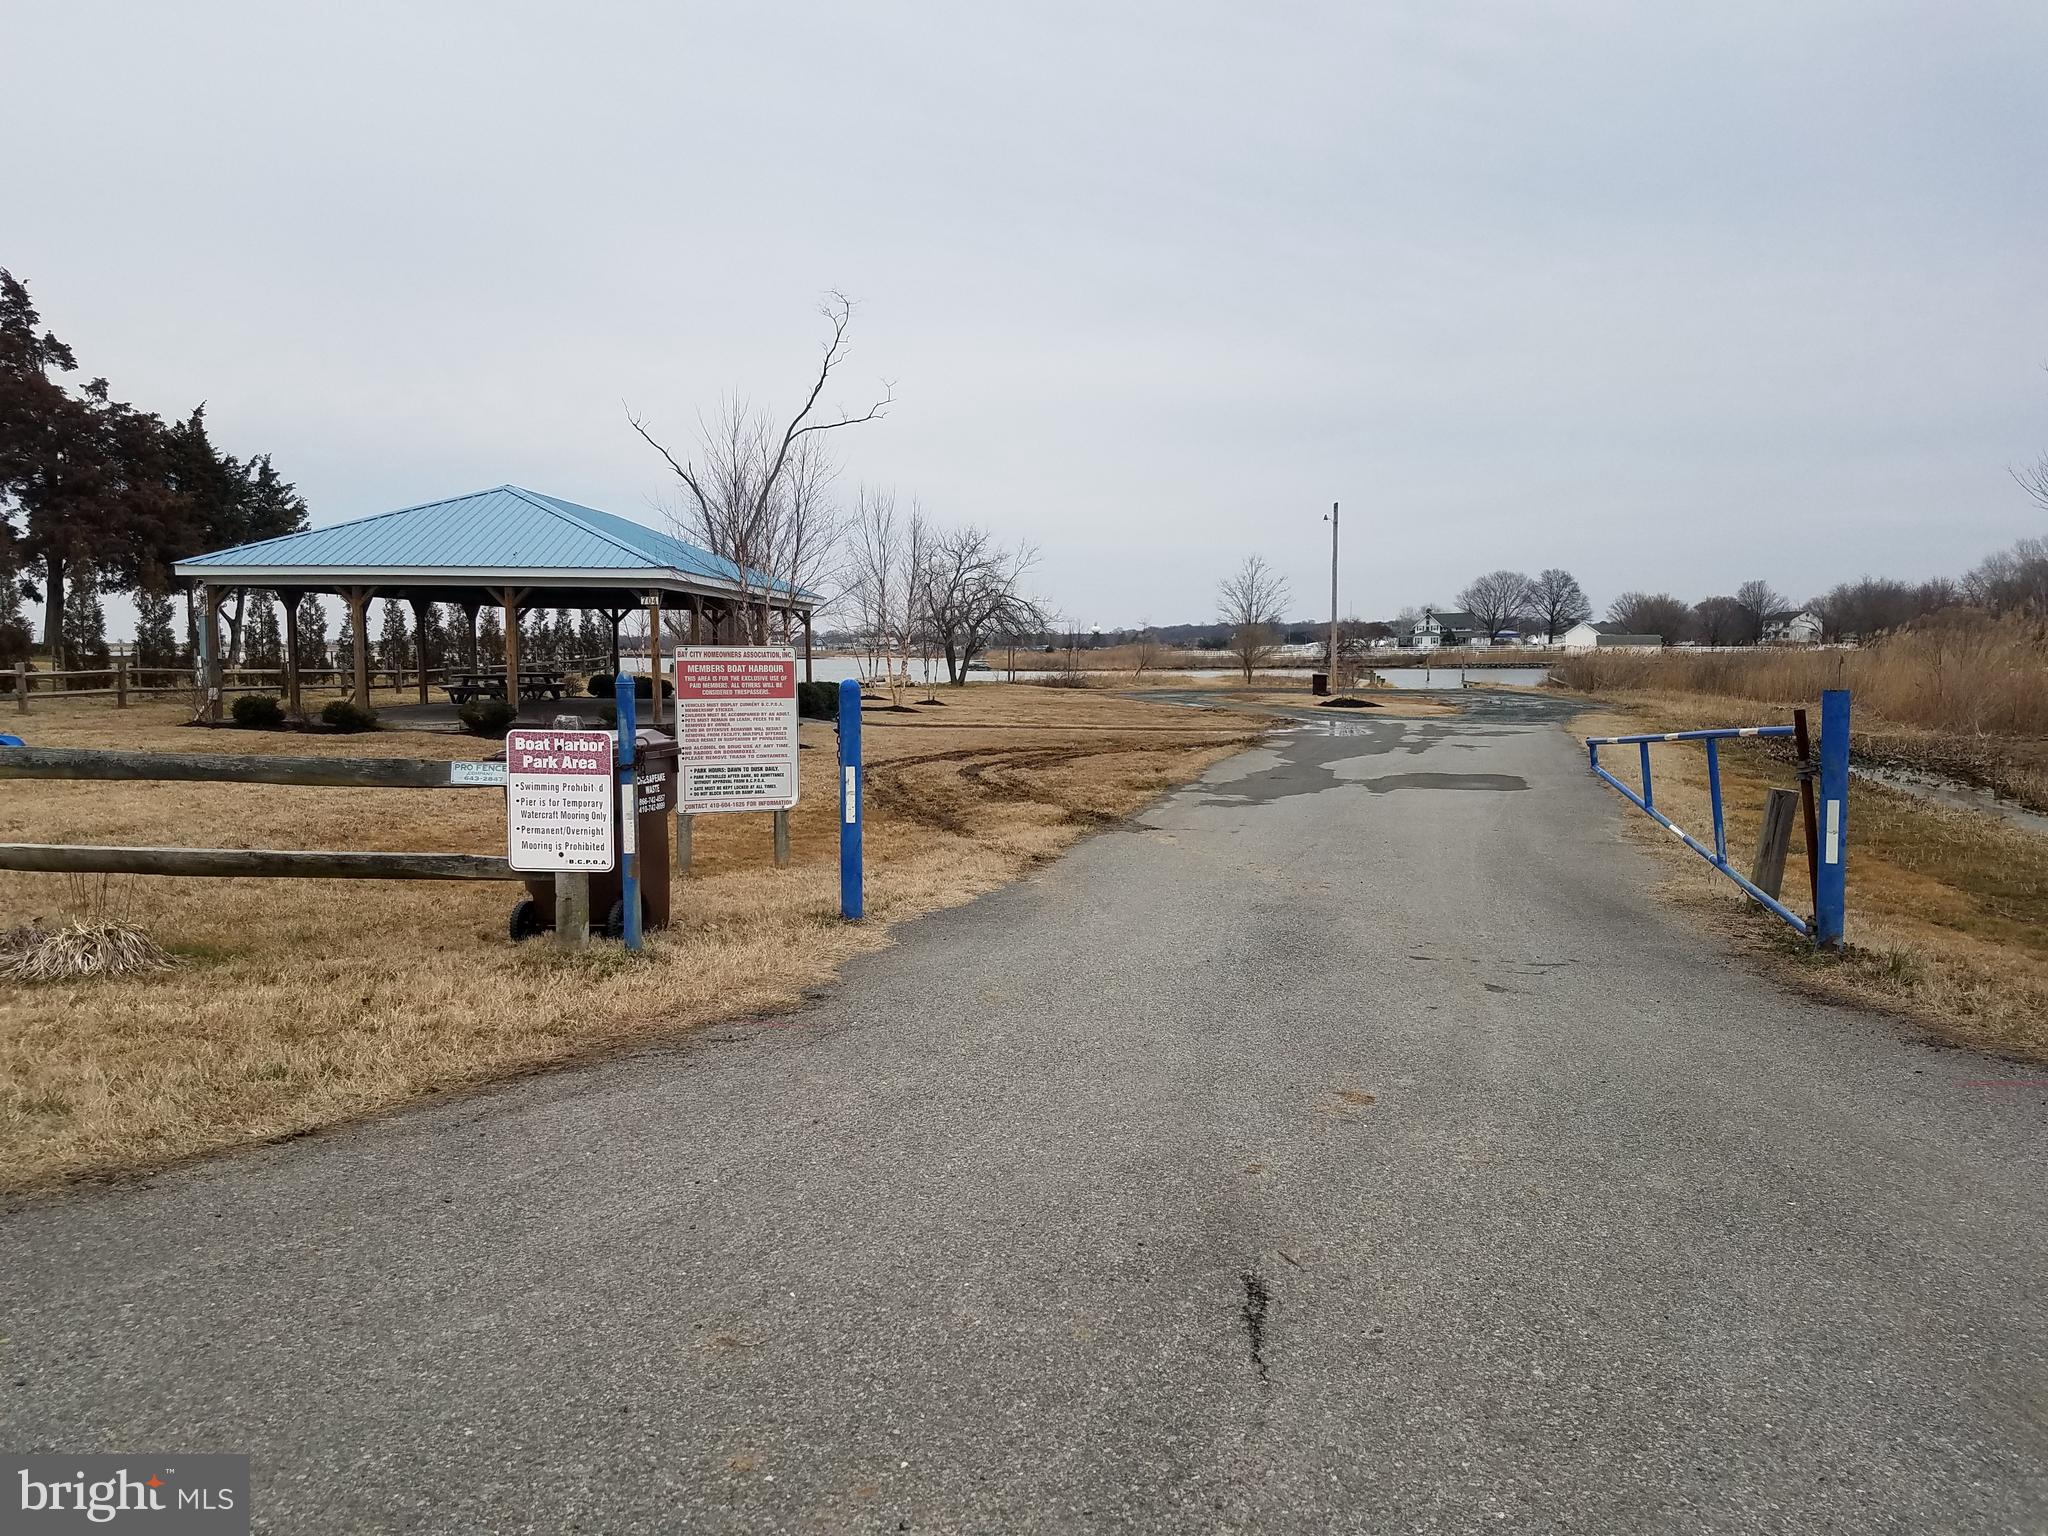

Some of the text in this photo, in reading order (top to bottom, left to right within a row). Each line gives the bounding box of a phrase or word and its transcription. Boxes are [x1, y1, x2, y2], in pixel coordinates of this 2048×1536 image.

[516, 738, 604, 751] Boat Harbor
[523, 755, 596, 769] Park Area
[476, 764, 507, 772] FENCE
[520, 782, 603, 793] Swimming Prohibitd
[646, 784, 660, 794] WASTE
[520, 798, 537, 807] Pier
[539, 798, 546, 807] is
[563, 798, 603, 809] Temporary
[521, 810, 607, 822] Watercraft Mooring Only
[521, 826, 604, 836] Permanent/Overnight
[522, 841, 604, 851] Mooring is Prohibited
